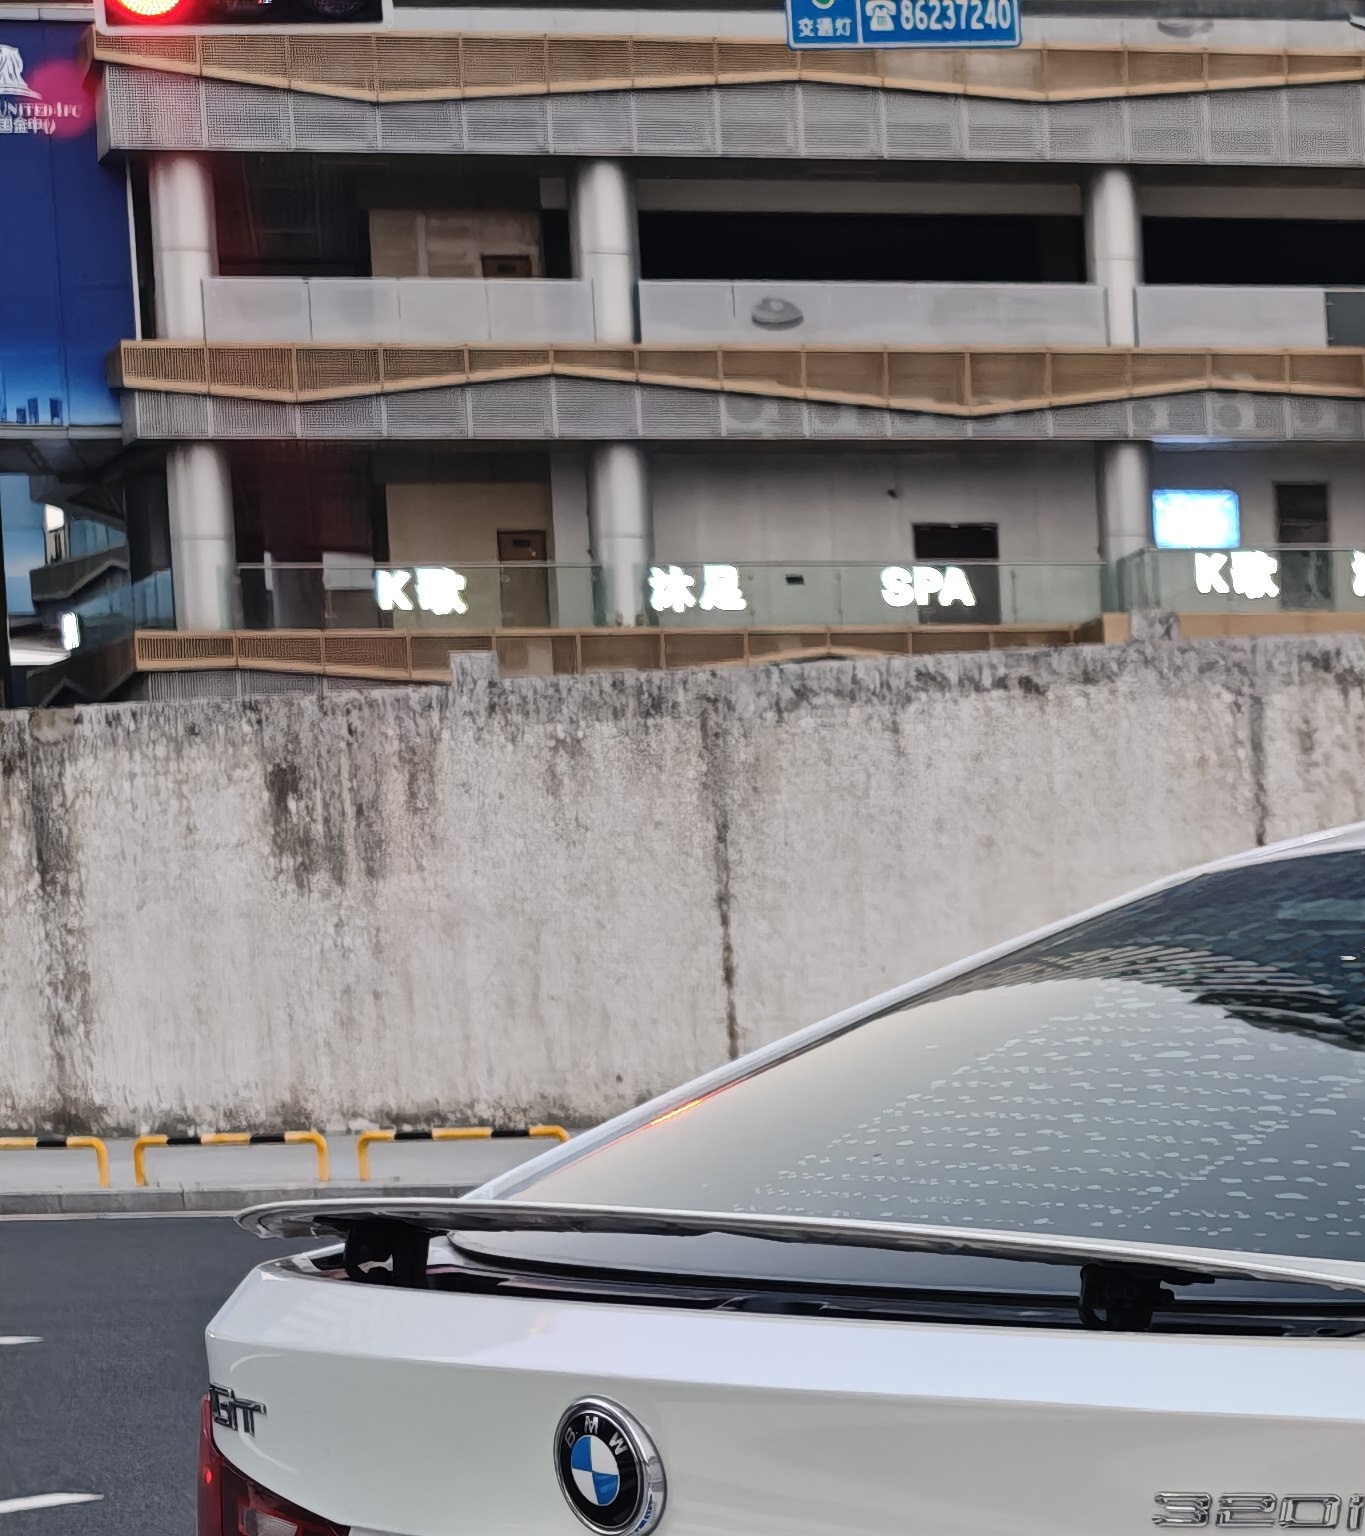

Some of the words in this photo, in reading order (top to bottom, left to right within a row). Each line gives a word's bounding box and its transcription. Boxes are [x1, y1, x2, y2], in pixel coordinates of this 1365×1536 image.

[797, 17, 852, 37] 交通灯
[900, 0, 1012, 30] 86237240
[880, 564, 976, 607] SPA
[564, 1415, 628, 1456] BMW
[1151, 1491, 1365, 1532] 320i
